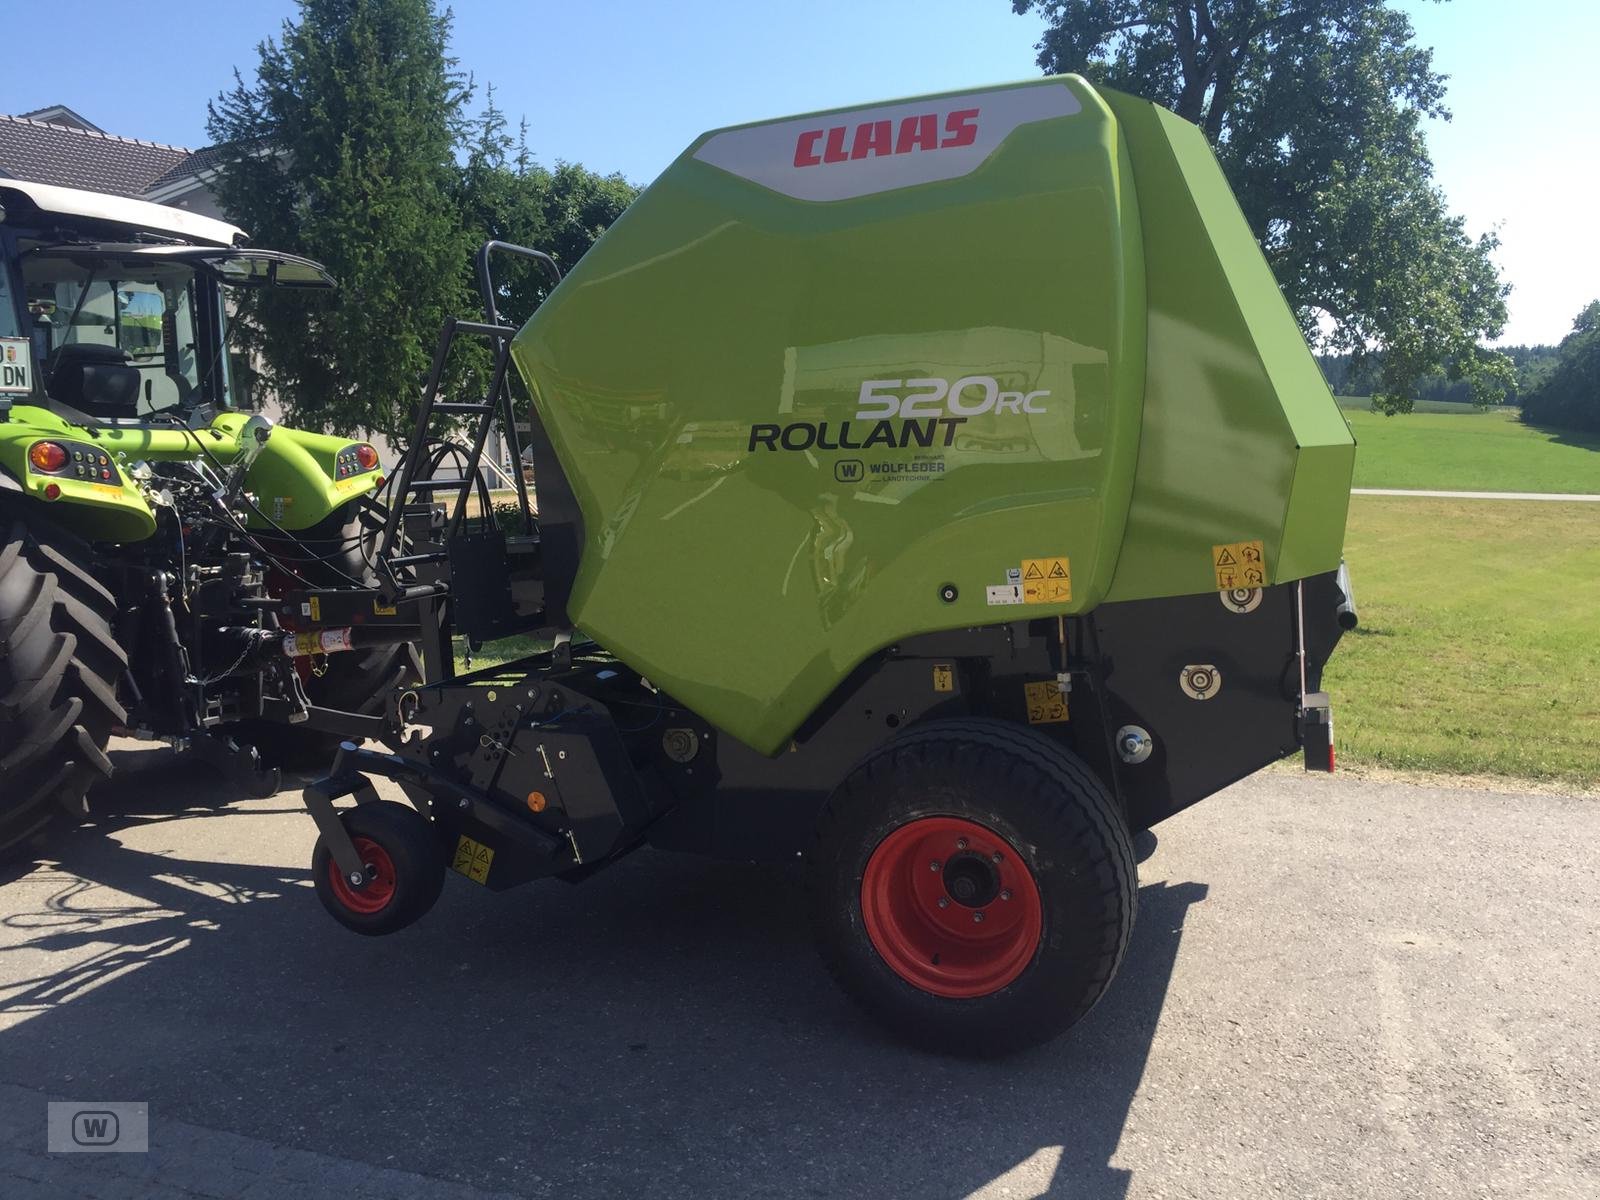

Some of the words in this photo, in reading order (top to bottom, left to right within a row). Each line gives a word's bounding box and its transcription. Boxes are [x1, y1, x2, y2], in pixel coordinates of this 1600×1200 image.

[793, 108, 980, 168] CLAAS
[3, 365, 26, 387] DN
[747, 417, 968, 452] ROLLANT
[870, 461, 945, 474] WÖLFLEDER
